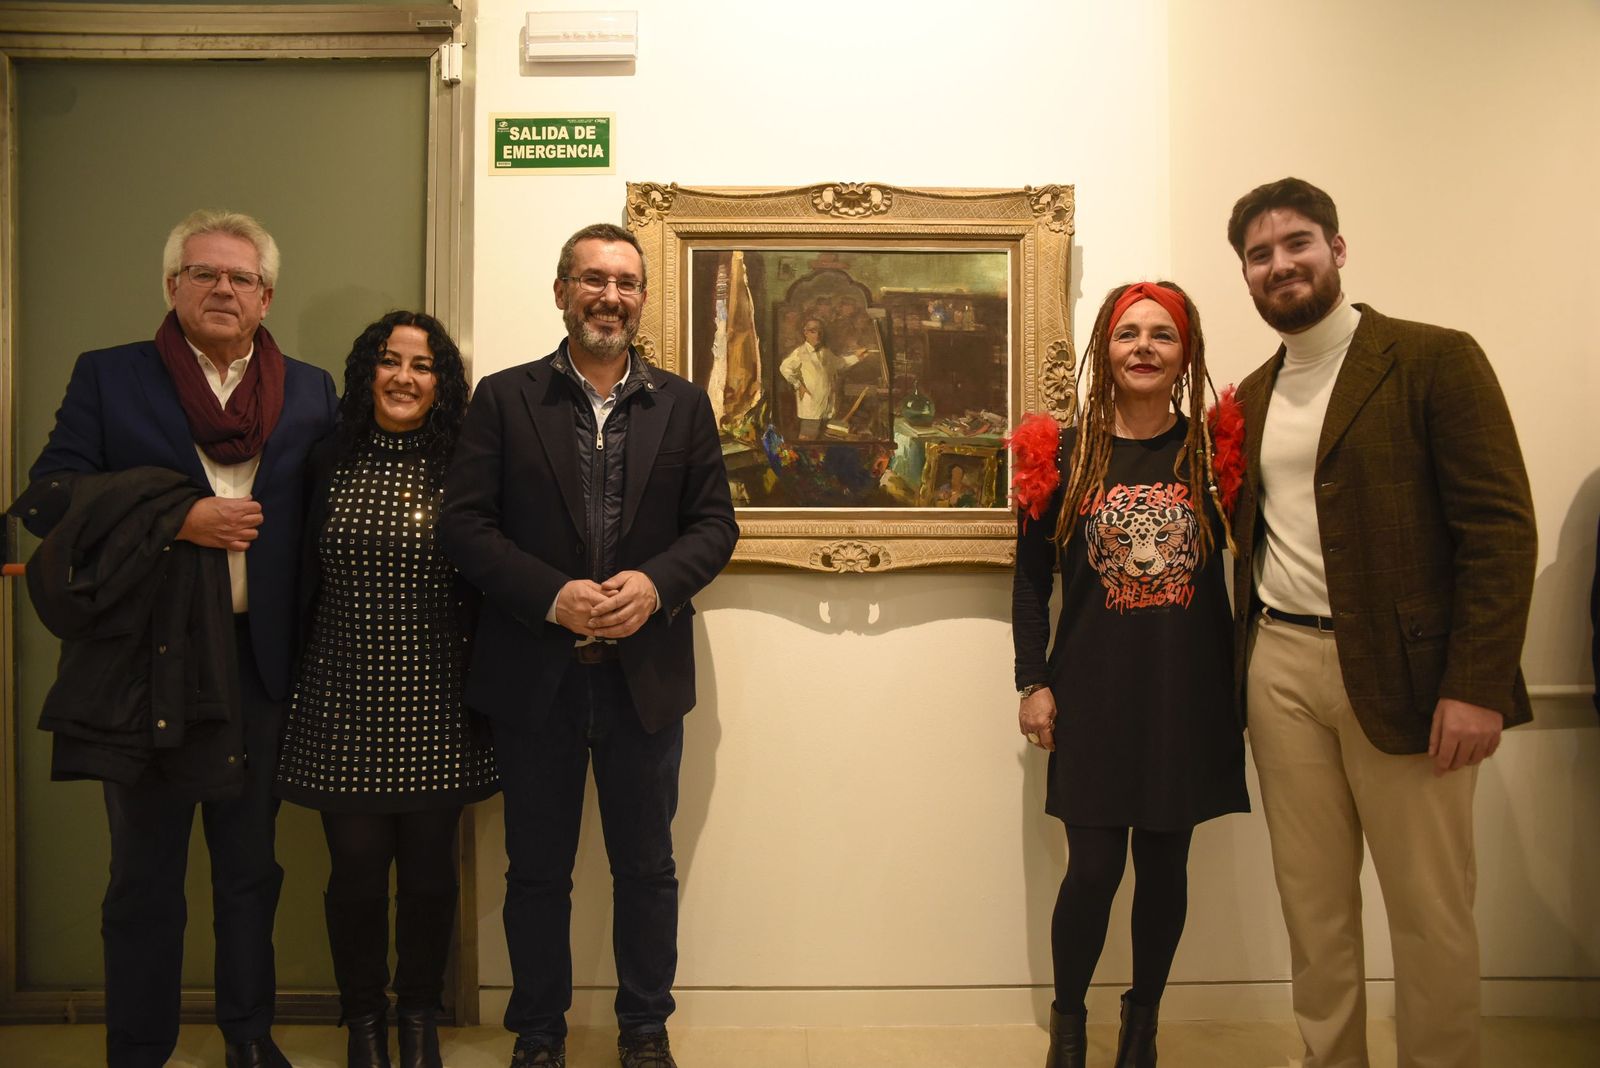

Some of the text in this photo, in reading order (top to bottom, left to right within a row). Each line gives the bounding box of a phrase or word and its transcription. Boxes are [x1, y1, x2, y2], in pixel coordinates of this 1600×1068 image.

[509, 125, 596, 141] SALIDA DE
[503, 144, 604, 159] EMERGENCIA
